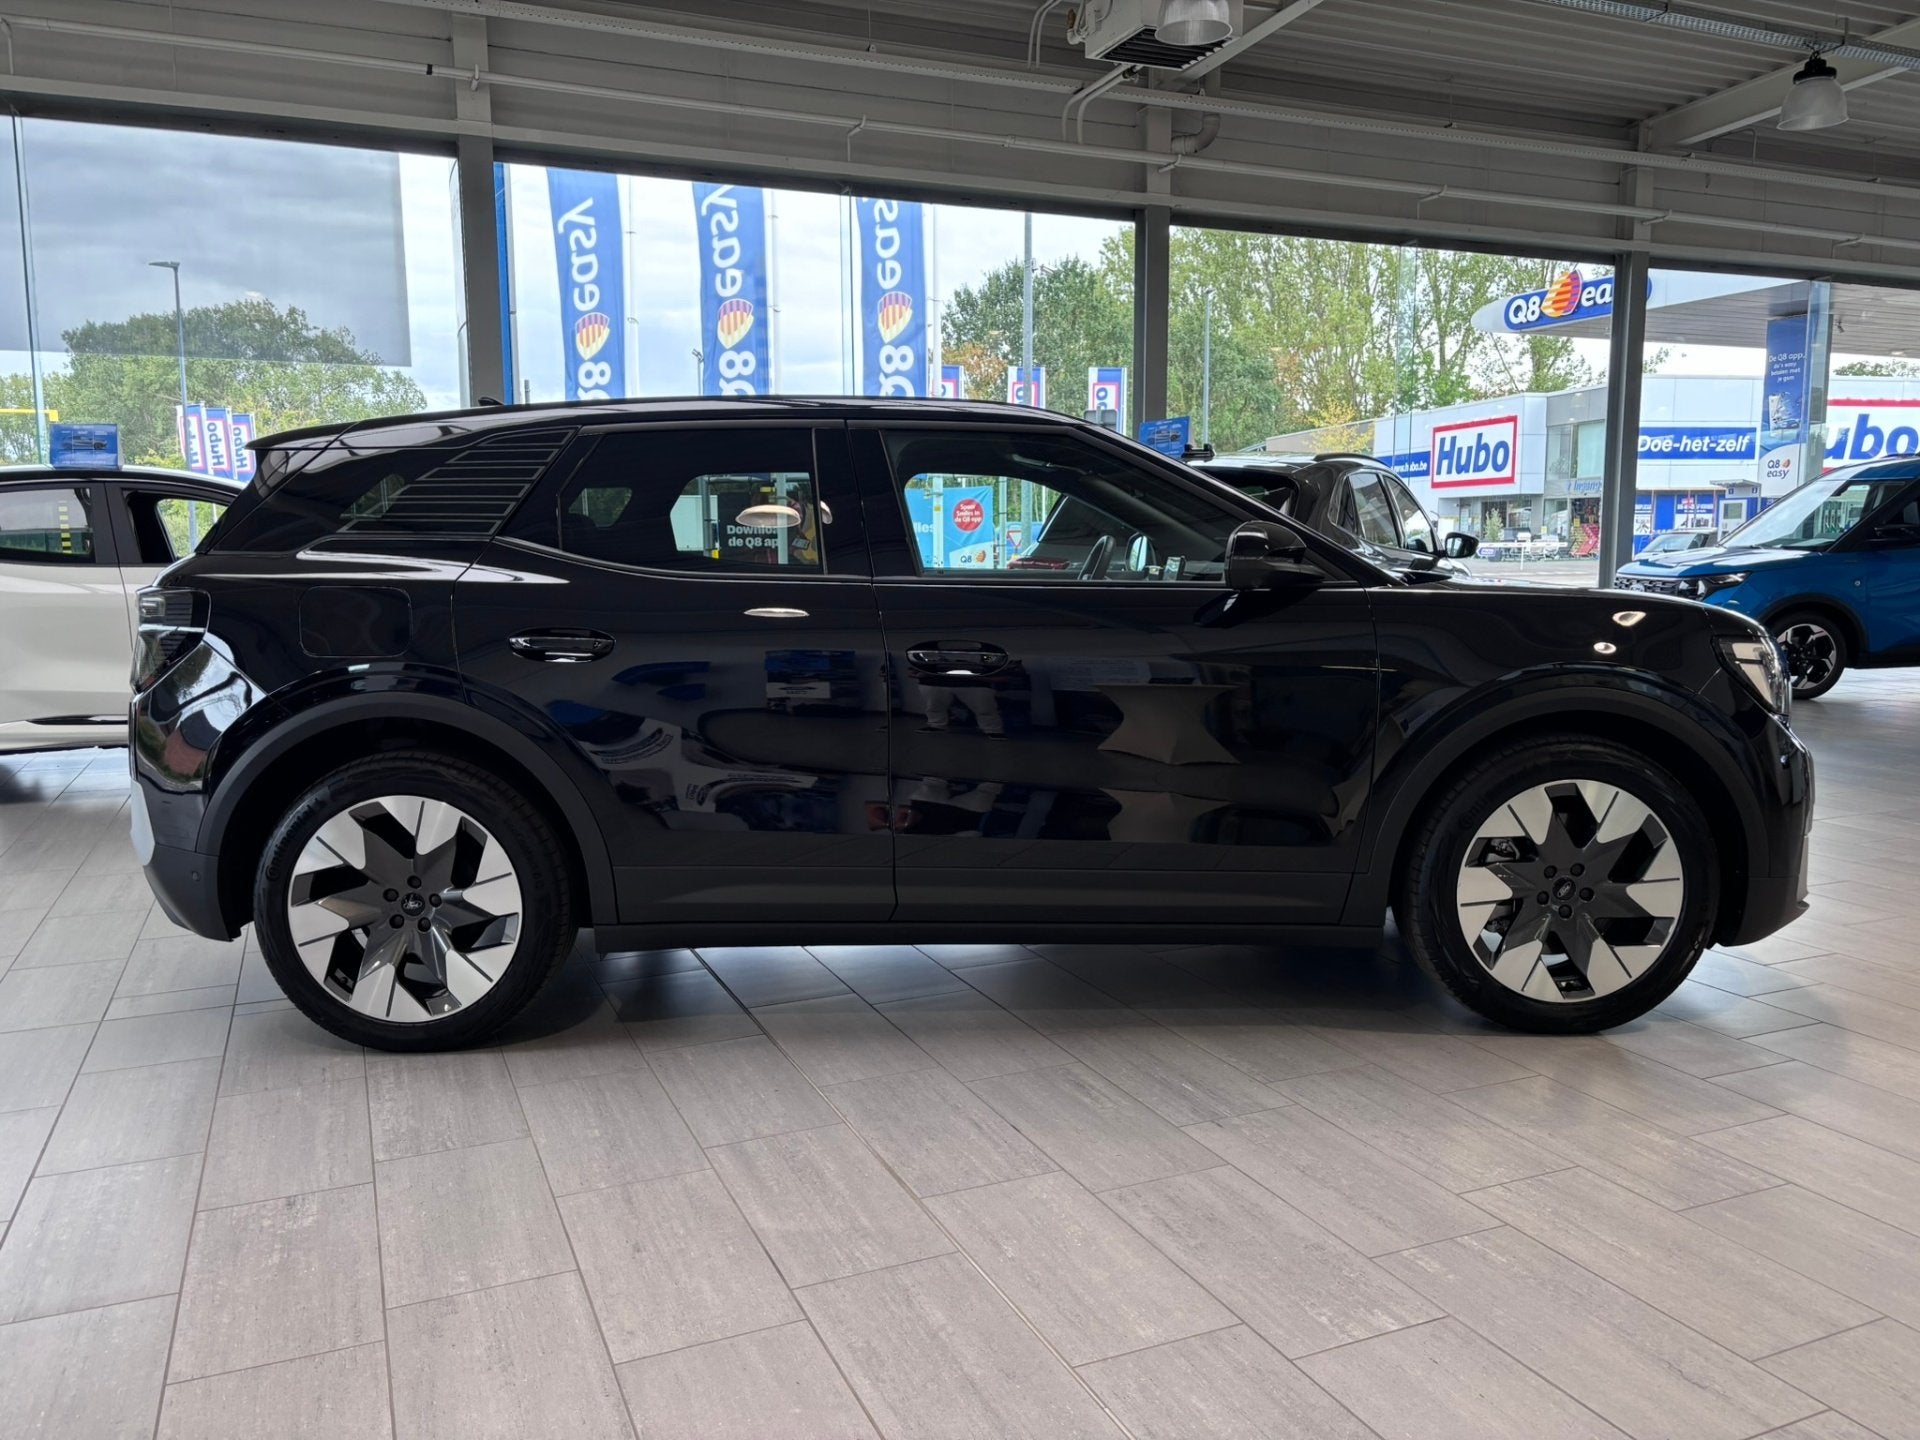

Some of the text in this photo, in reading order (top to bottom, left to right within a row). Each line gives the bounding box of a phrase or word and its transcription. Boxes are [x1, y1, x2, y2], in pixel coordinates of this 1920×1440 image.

[1508, 283, 1613, 324] Q8 ea
[1823, 413, 1919, 460] ubo
[1638, 435, 1750, 452] Doe-het-zelf
[1436, 432, 1510, 476] Hubo
[1767, 459, 1781, 469] Q8
[1766, 468, 1790, 479] easy
[727, 525, 778, 534] Downloa
[728, 537, 778, 549] de Q8 ap
[960, 555, 972, 563] Q8
